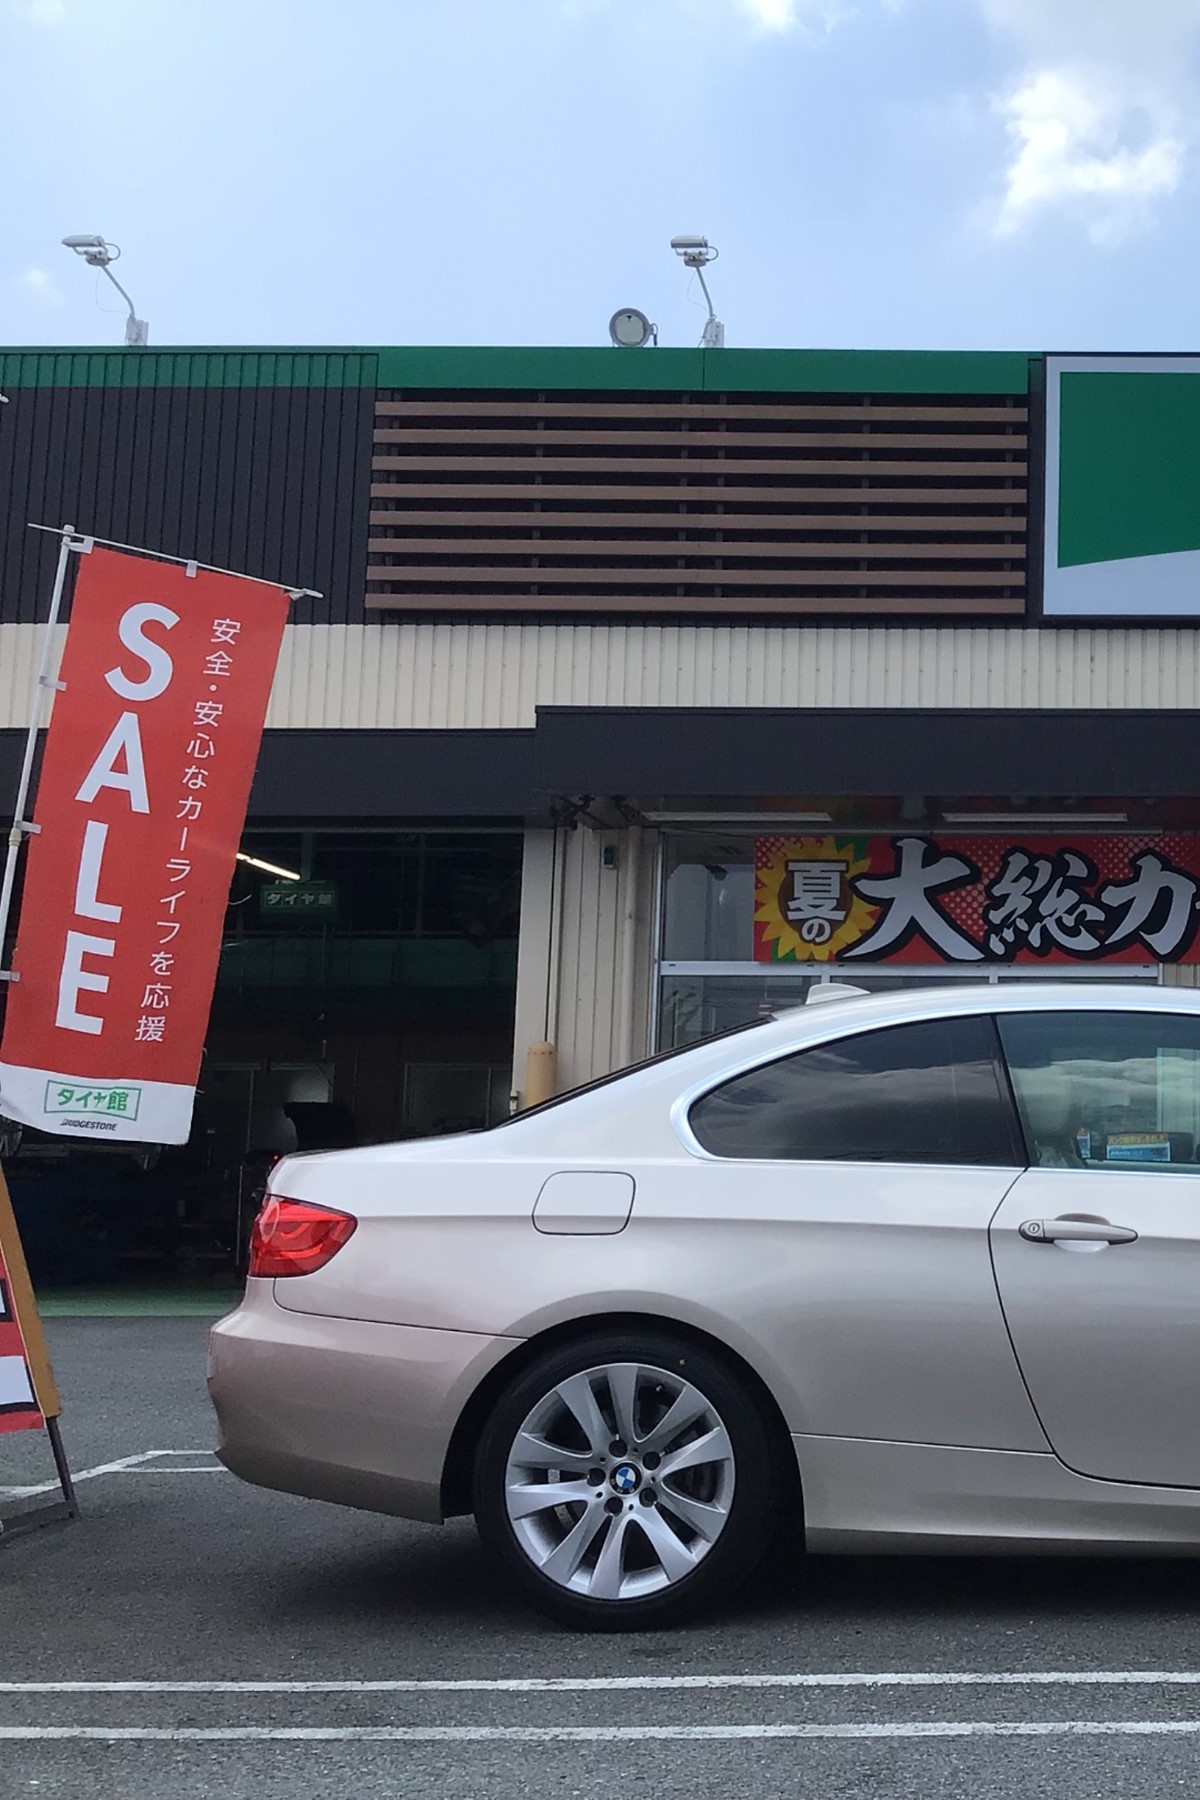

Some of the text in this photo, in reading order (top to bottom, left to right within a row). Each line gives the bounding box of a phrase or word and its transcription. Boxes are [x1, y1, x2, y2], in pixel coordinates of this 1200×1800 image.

[54, 602, 181, 1035] SALE
[135, 618, 241, 1043] 安全・安心なカーライフを応援
[787, 861, 849, 942] 夏の
[57, 1088, 129, 1111] タイヤ館
